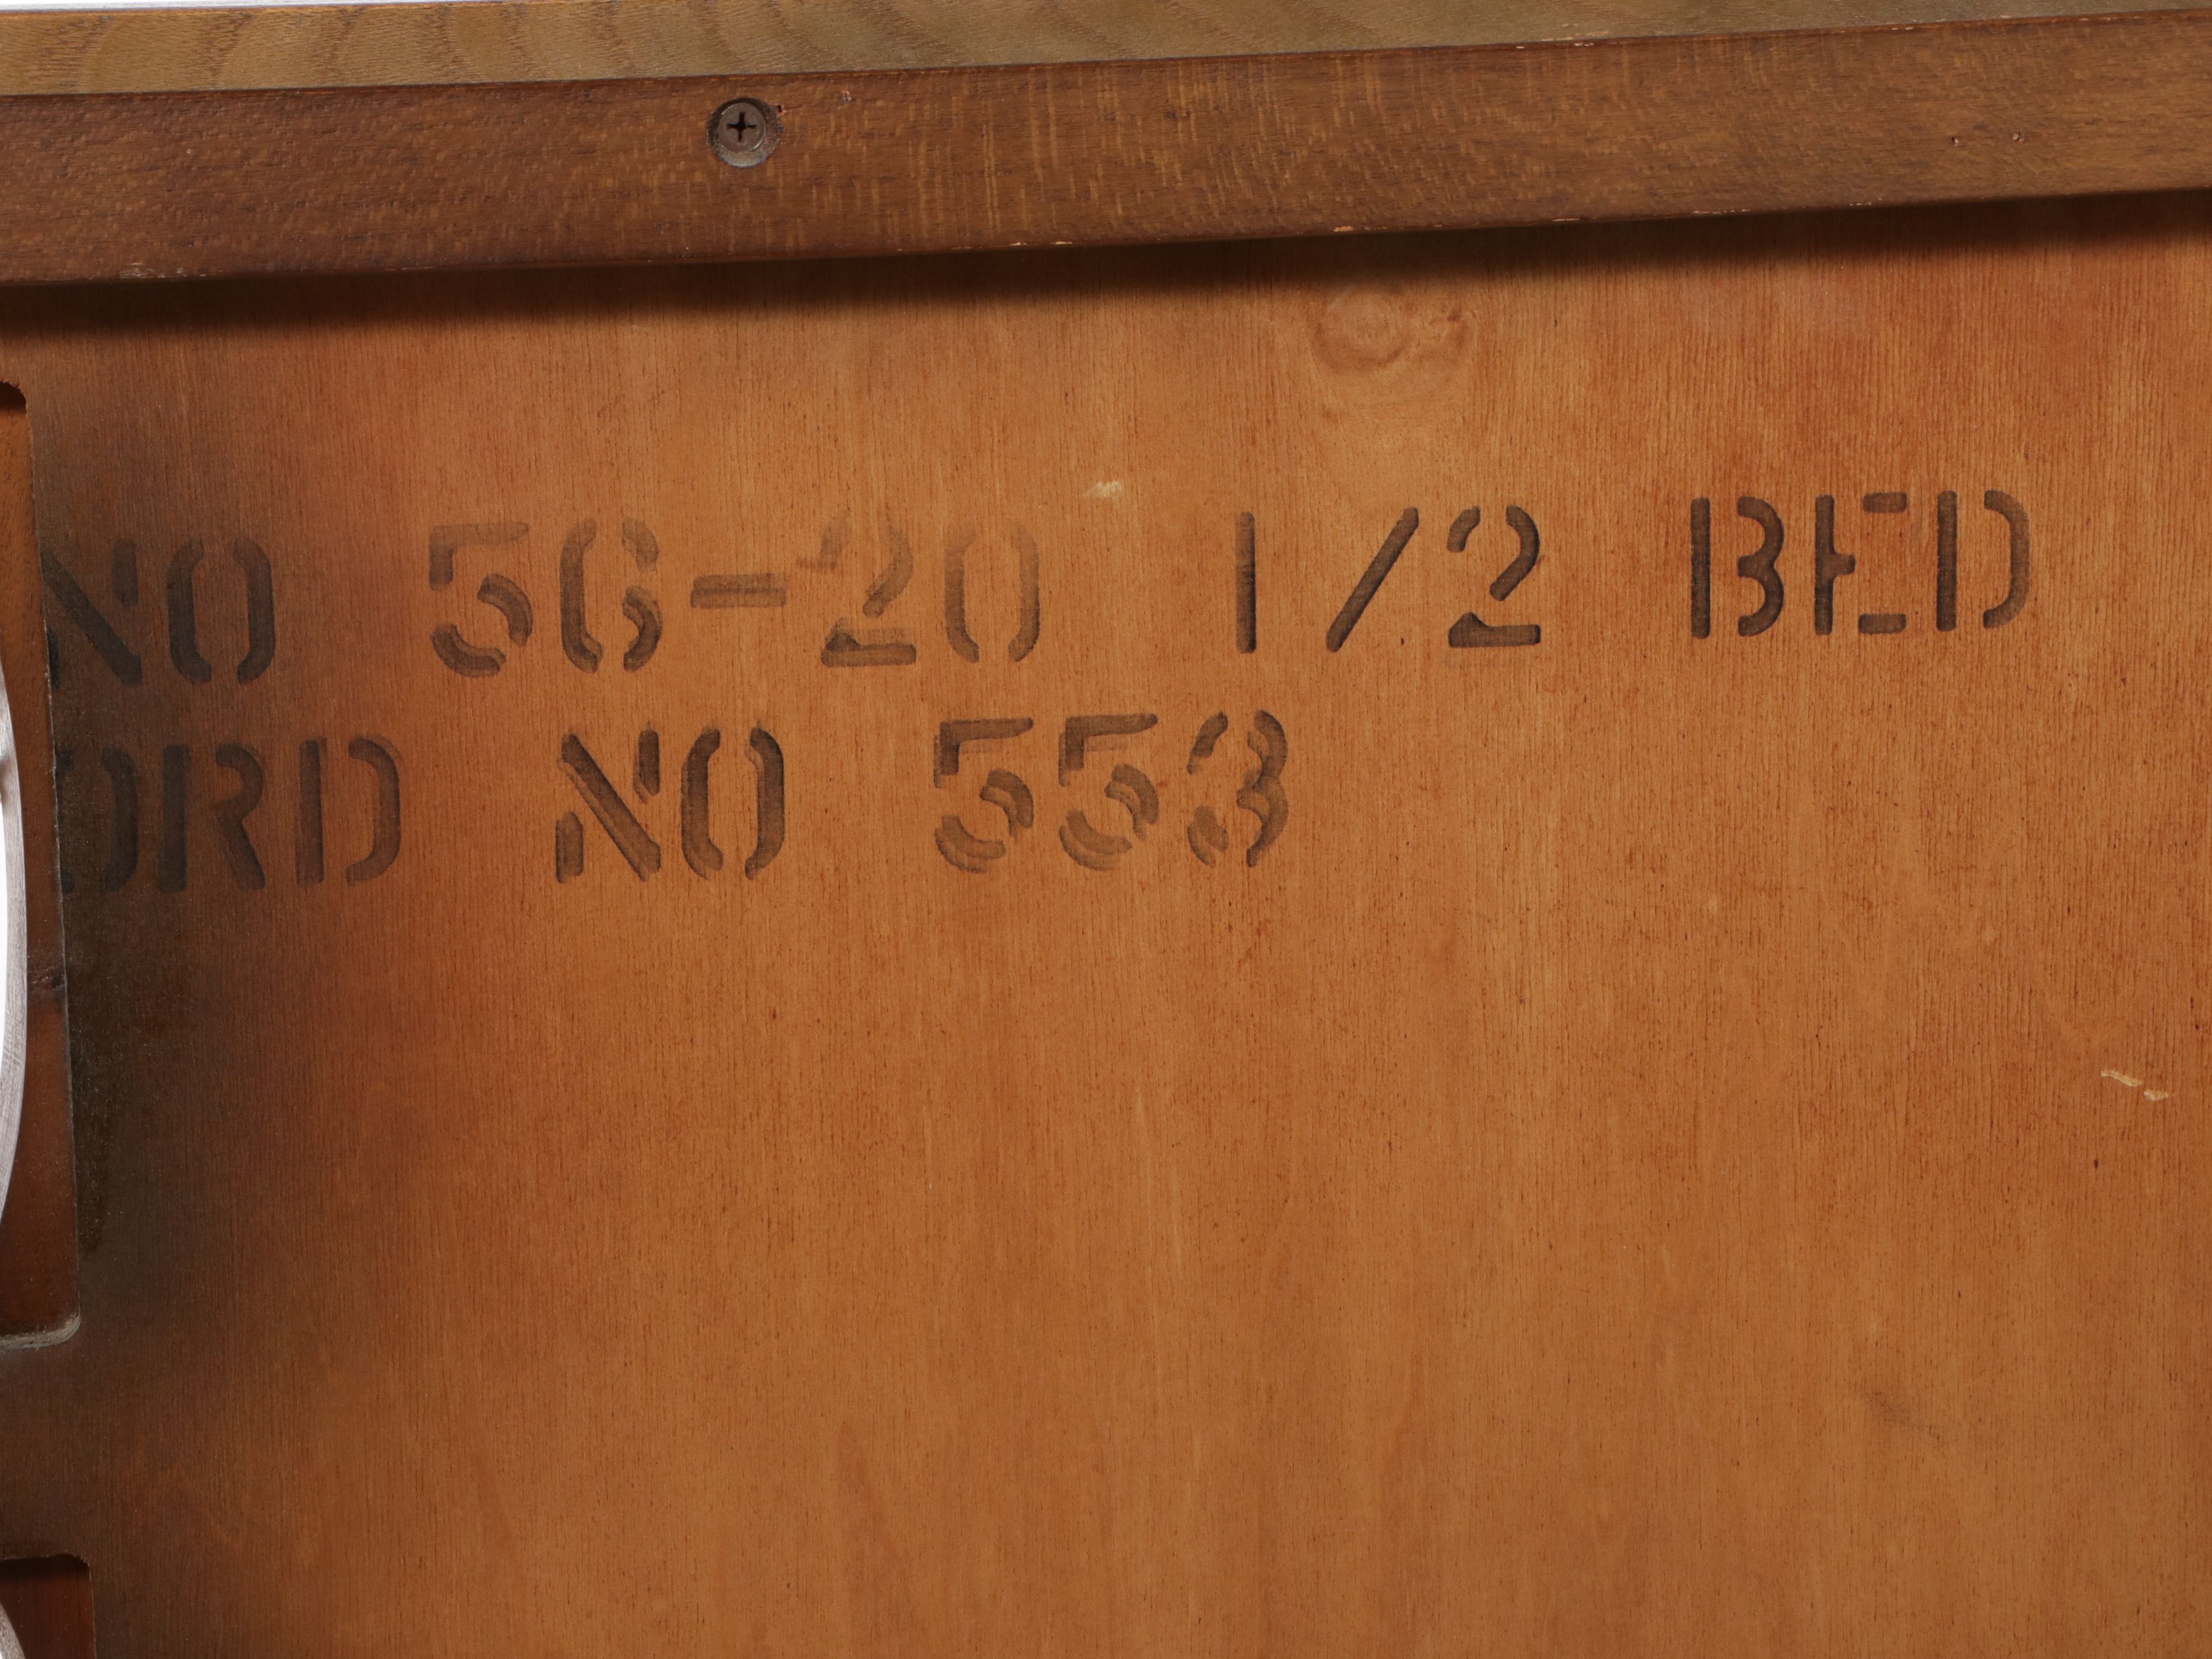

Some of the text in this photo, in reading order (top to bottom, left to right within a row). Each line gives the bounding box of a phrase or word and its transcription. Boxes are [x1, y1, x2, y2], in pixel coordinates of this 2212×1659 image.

[41, 537, 276, 685] NO
[430, 508, 1041, 678] 56-20
[1690, 489, 2032, 638] BED
[555, 727, 785, 882] NO
[933, 709, 1288, 872] 553
